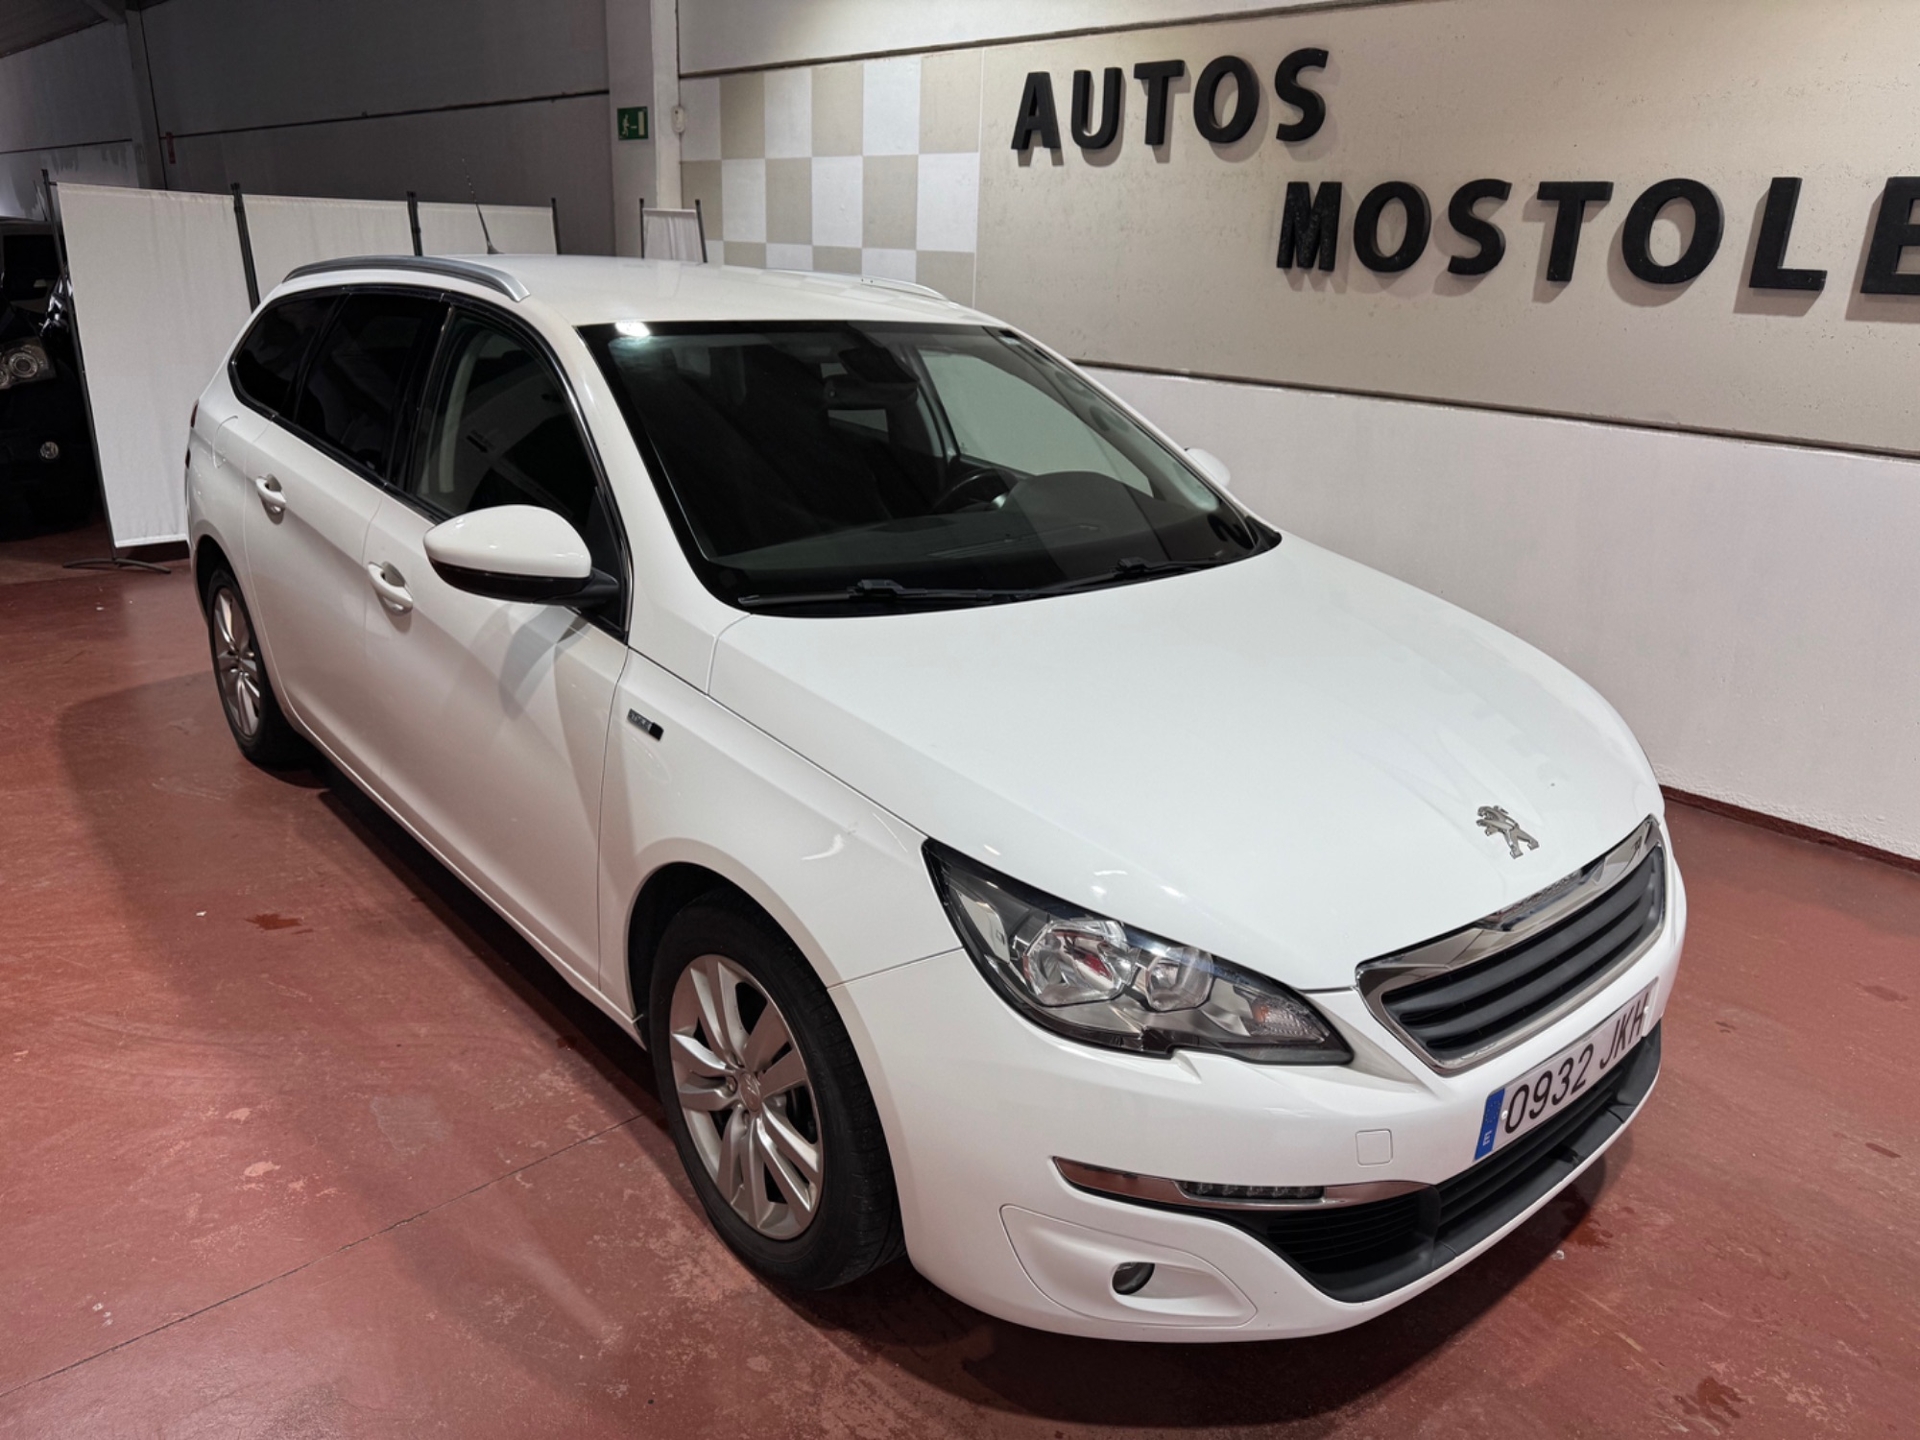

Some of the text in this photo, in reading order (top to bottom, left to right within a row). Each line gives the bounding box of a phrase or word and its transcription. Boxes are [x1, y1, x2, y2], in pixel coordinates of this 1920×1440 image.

[1011, 47, 1329, 150] AUTOS
[1276, 176, 1920, 295] MOSTOLE
[1504, 991, 1650, 1134] 0932 JKH
[1482, 1130, 1492, 1146] E
